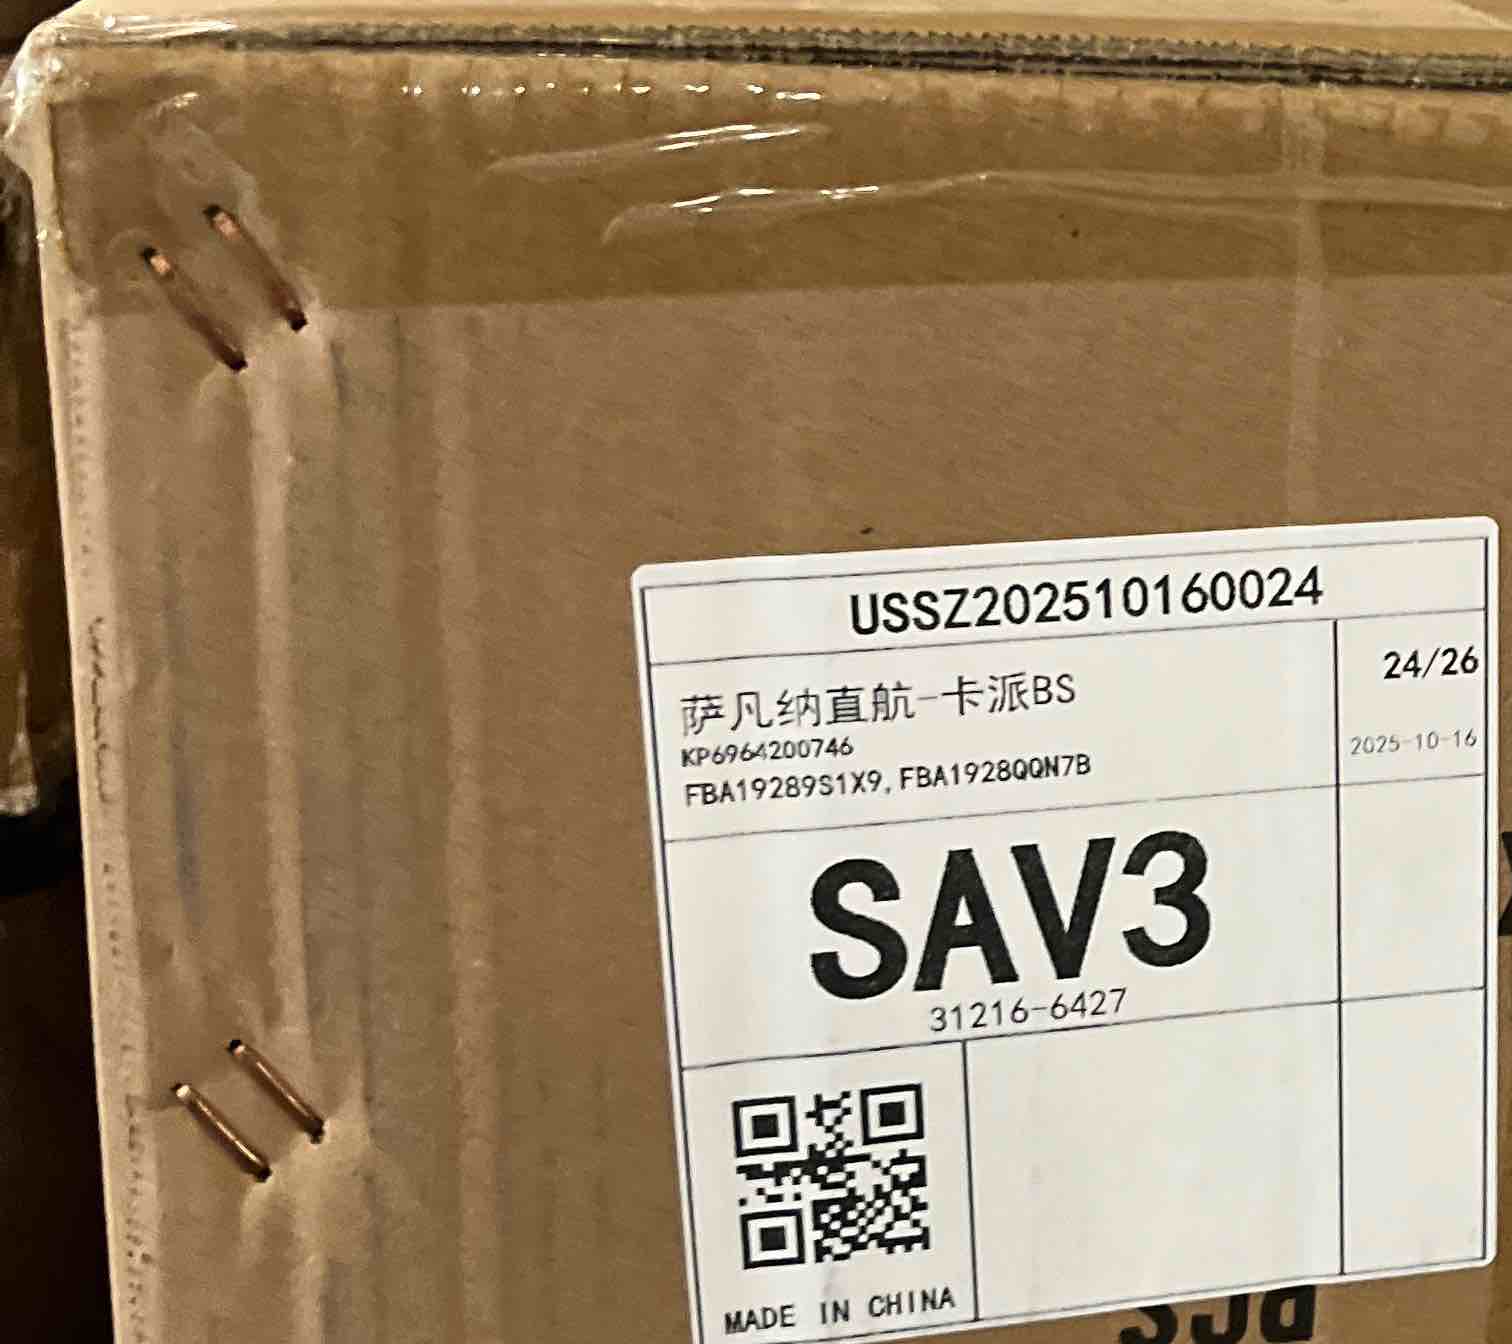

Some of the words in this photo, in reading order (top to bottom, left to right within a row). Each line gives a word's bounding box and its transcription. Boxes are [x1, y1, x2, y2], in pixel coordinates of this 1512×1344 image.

[850, 566, 1323, 635] USSZ202510160024
[1383, 647, 1479, 682] 24/26
[682, 737, 855, 768] KP6964200746
[1350, 728, 1478, 758] 2025-10-16
[810, 830, 1212, 1001] SAV3
[929, 988, 1127, 1034] 31216-6427
[724, 1305, 795, 1334] MADE
[820, 1299, 851, 1324] IN
[868, 1287, 956, 1317] CHINA
